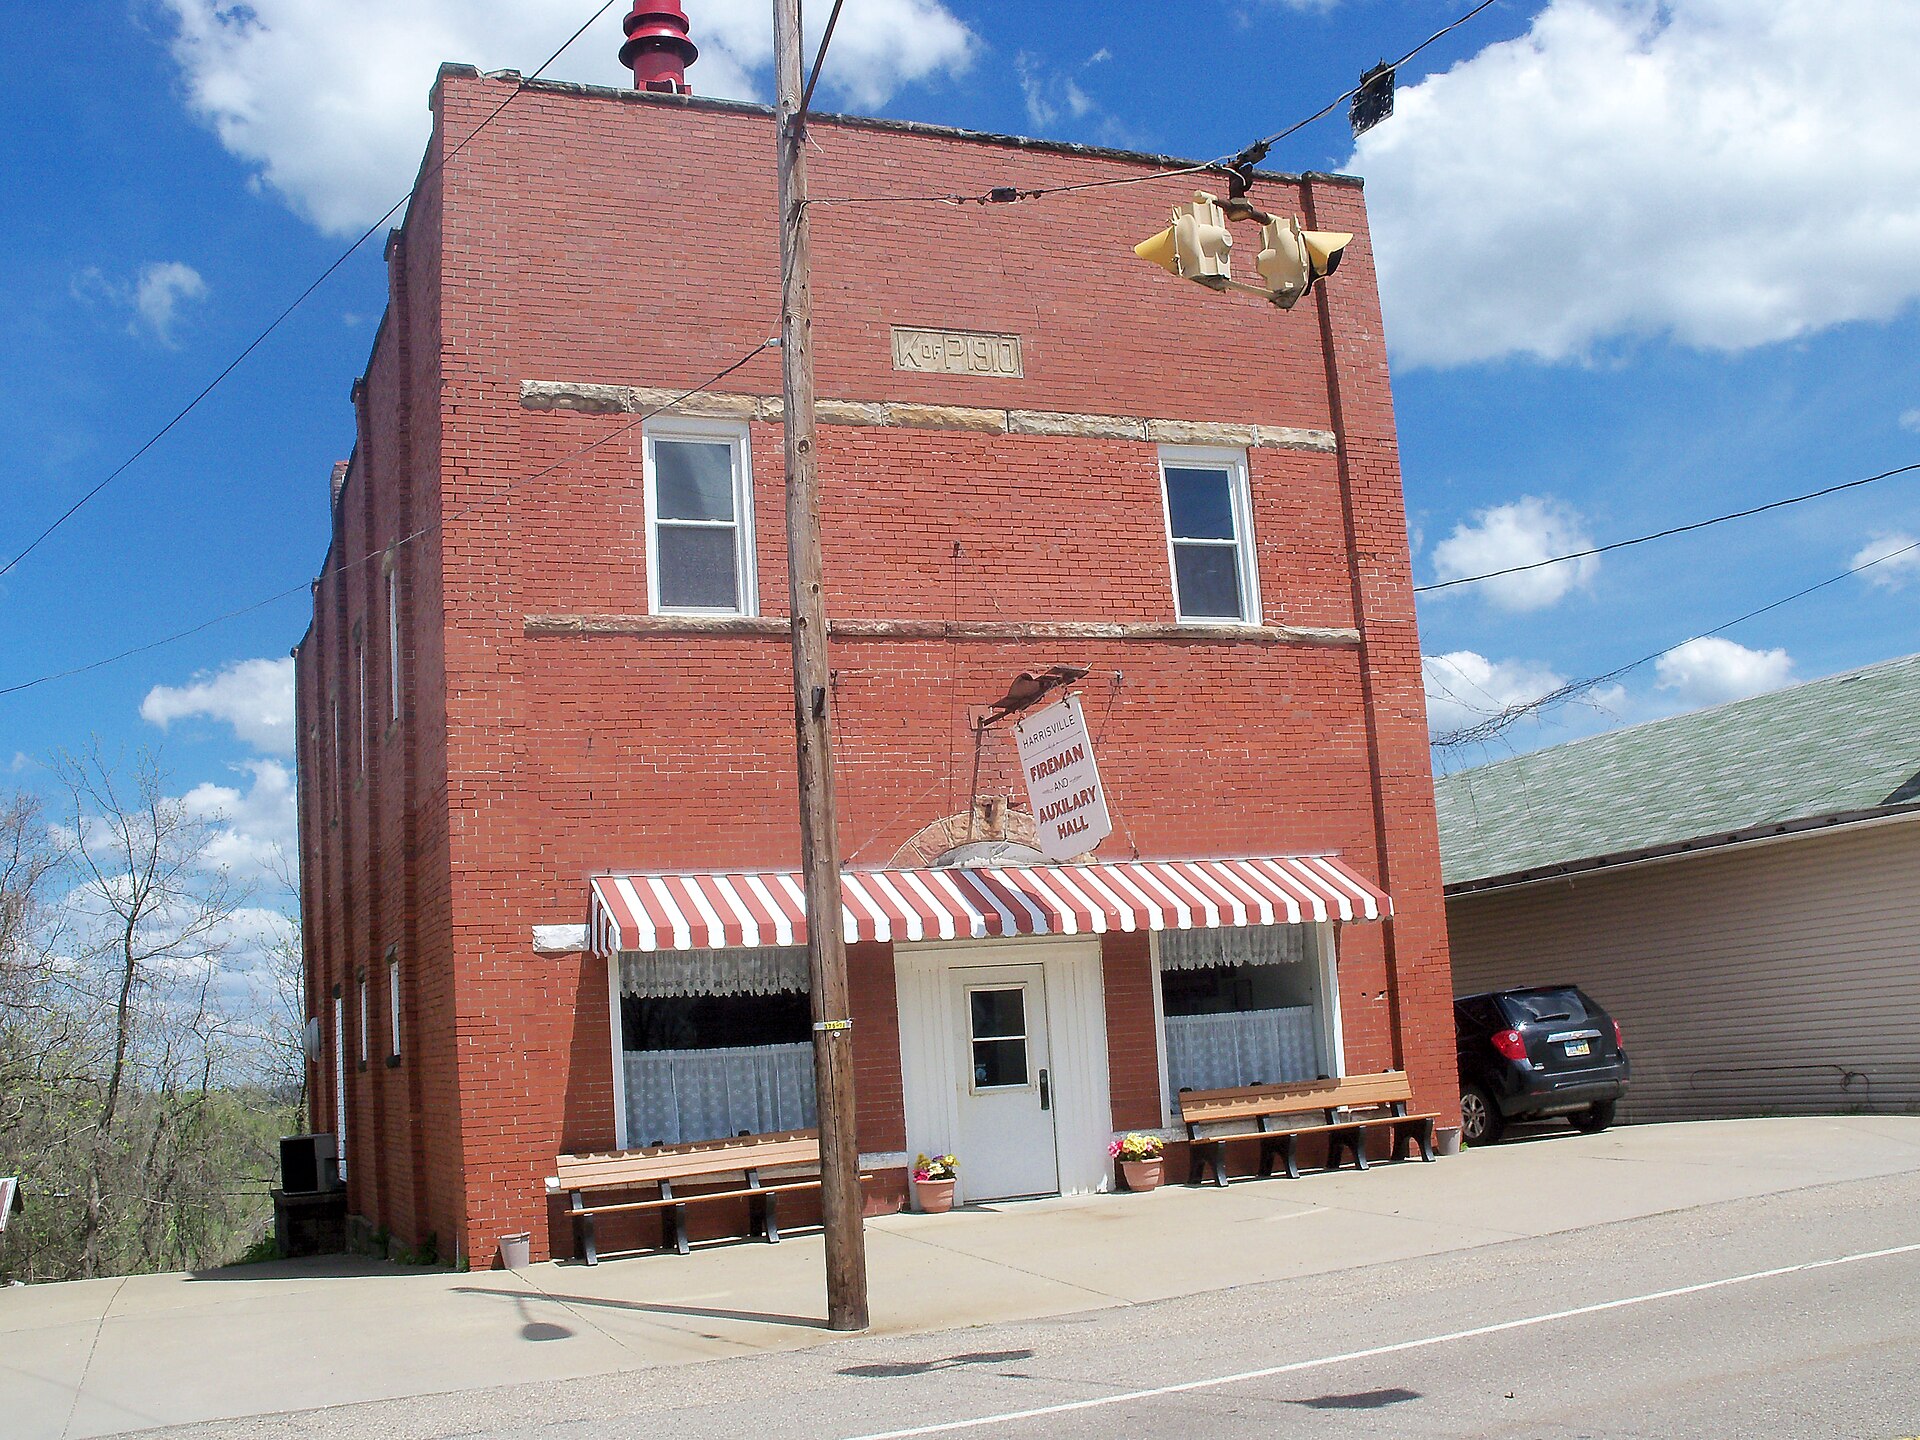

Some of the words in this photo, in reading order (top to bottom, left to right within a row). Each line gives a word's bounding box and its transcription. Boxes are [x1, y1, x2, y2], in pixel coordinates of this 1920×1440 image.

[896, 331, 921, 368] K
[1022, 714, 1076, 749] HARRISVILLE
[1029, 743, 1085, 784] FIREMAN
[1053, 777, 1069, 793] AND
[1038, 785, 1097, 826] AUXILARY
[1056, 815, 1089, 840] HALL
